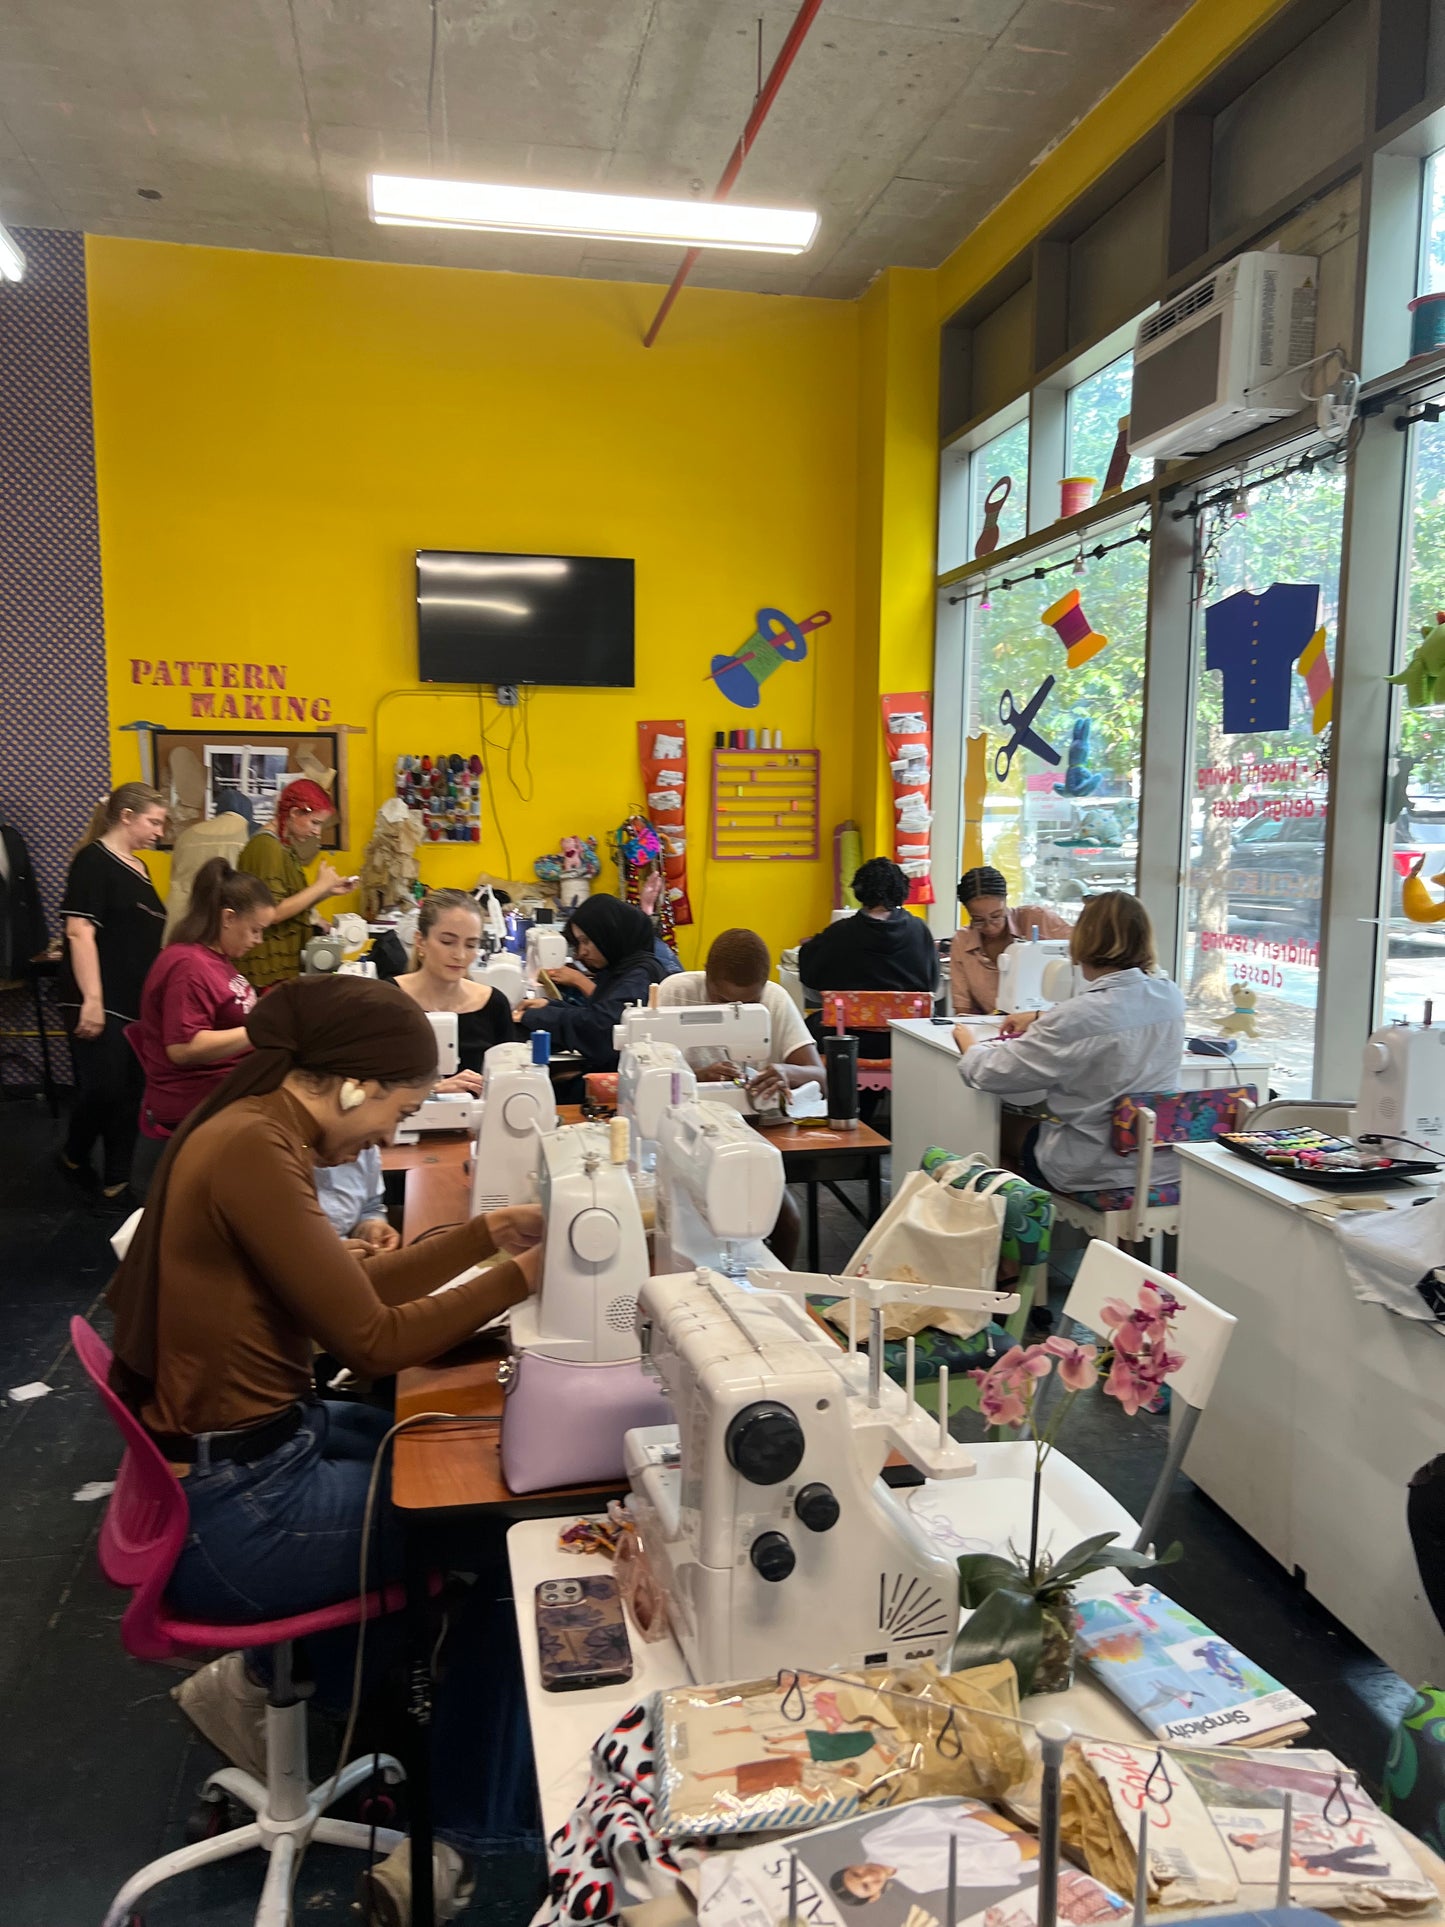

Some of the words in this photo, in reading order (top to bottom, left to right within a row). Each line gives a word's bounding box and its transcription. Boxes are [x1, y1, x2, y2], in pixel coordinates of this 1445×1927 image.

[129, 658, 288, 690] PATTERN
[190, 692, 332, 722] MAKING
[1165, 1709, 1251, 1738] Simplicity
